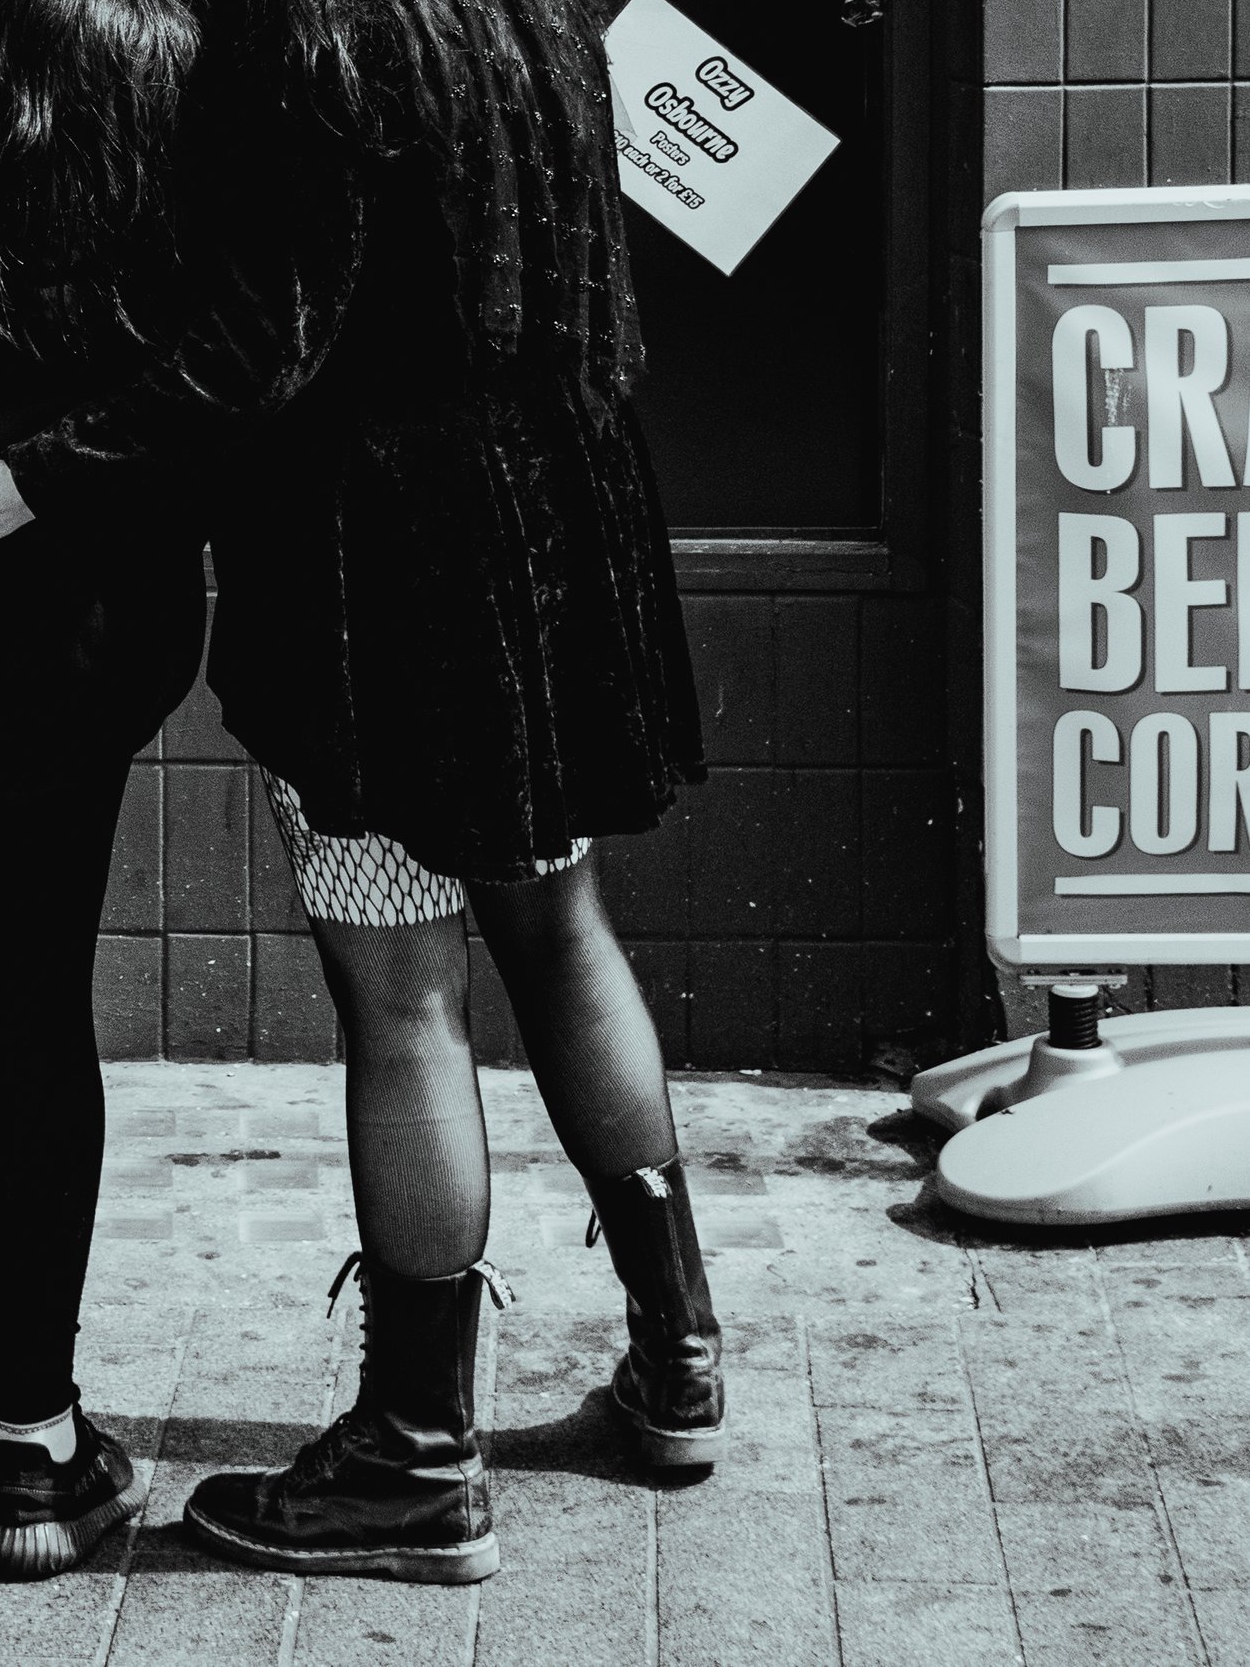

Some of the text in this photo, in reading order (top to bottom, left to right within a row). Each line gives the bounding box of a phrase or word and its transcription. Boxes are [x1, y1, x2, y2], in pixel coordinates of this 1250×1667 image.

[695, 56, 755, 111] Ozzy
[644, 82, 739, 163] Osbourne
[623, 145, 652, 169] each
[650, 130, 690, 166] Posters
[643, 162, 665, 177] or
[654, 169, 671, 184] 2
[662, 175, 686, 195] for
[676, 188, 706, 210] £15
[1052, 304, 1250, 491] CR
[1058, 511, 1250, 693] BE
